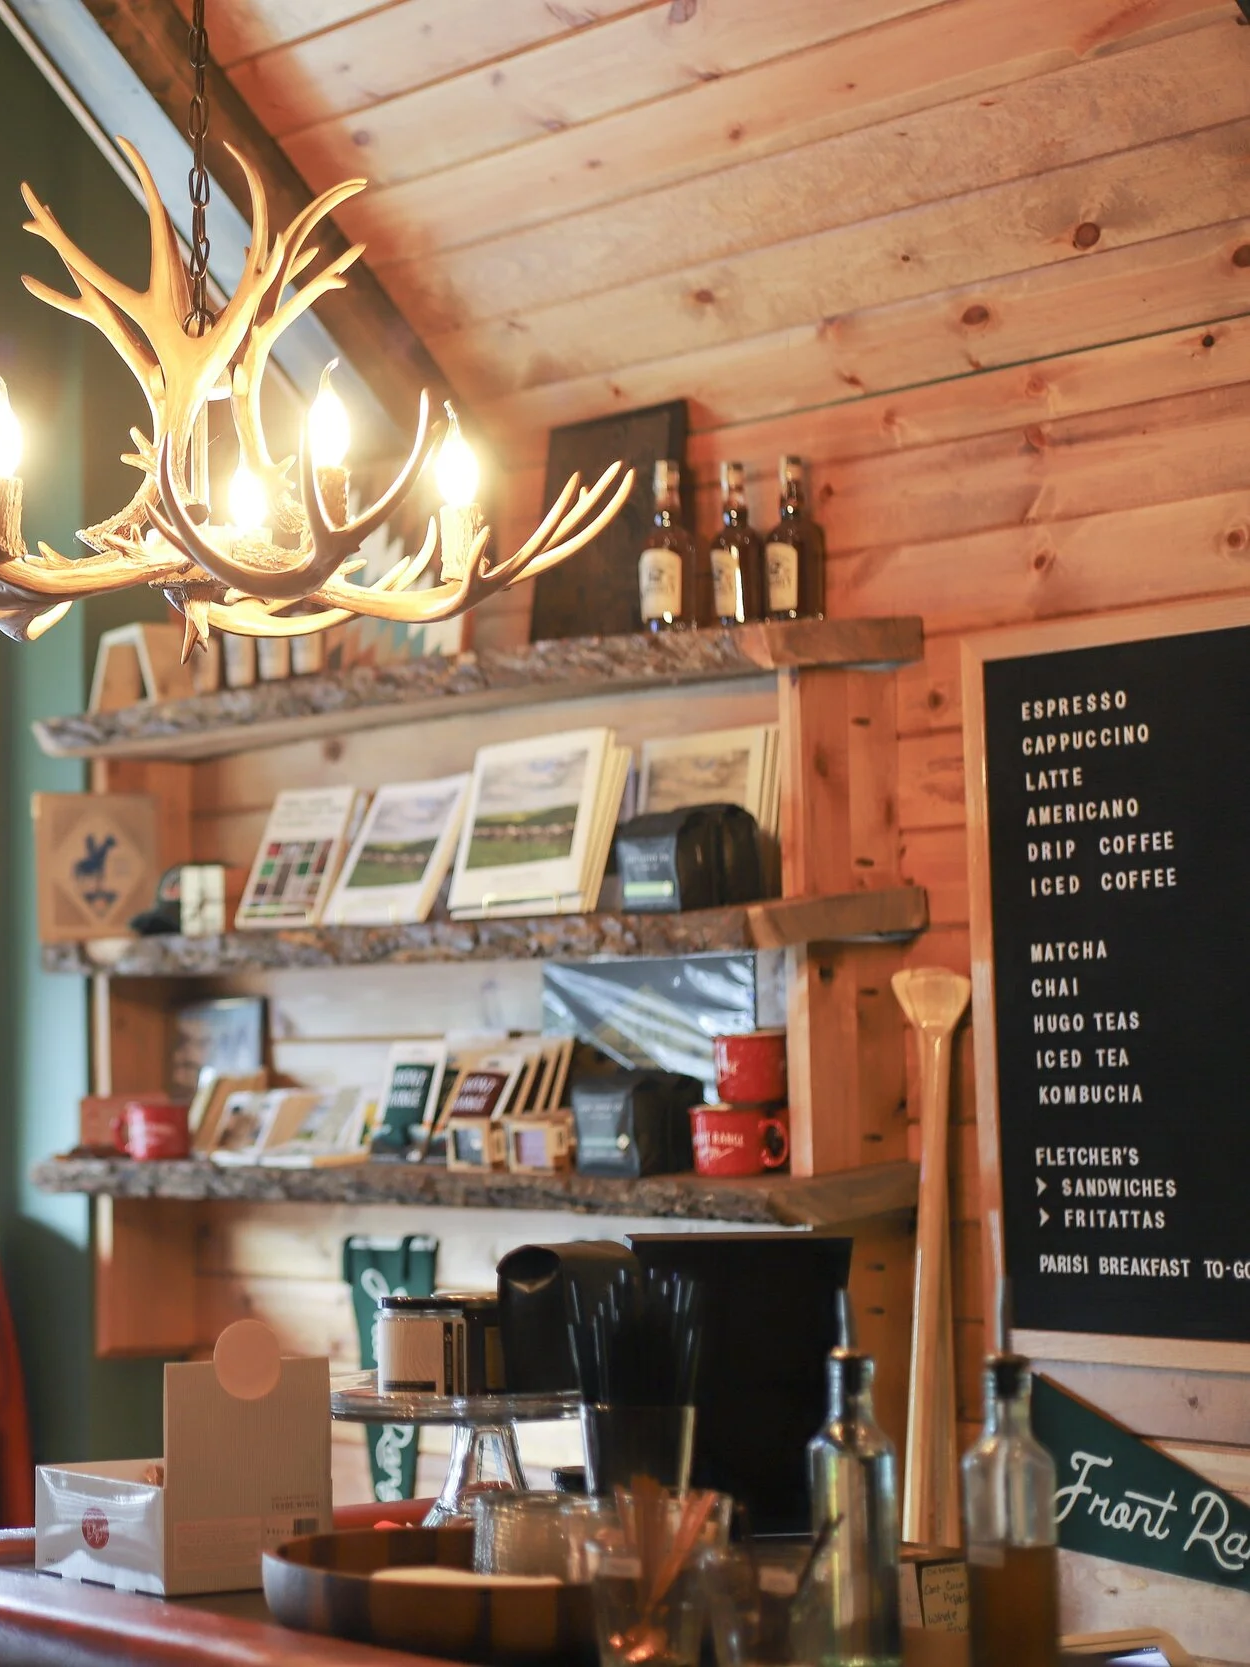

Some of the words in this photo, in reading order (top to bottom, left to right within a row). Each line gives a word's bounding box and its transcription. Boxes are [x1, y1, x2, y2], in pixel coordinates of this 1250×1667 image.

[1022, 691, 1126, 721] ESPRESSO
[1023, 724, 1148, 755] CAPPUCCINO
[1026, 767, 1082, 791] LATTE
[1027, 798, 1138, 826] AMERICANO
[1028, 840, 1075, 861] DRIP
[1099, 831, 1173, 855] COFFEE
[1031, 875, 1079, 896] ICED
[1101, 868, 1176, 891] COFFEE
[1031, 940, 1107, 962] MATCHA
[1032, 978, 1078, 997] CHAI
[1034, 1014, 1084, 1033] HUGO
[1094, 1012, 1139, 1031] TEAS
[1037, 1049, 1081, 1068] ICED
[1096, 1048, 1129, 1067] TEA
[1039, 1085, 1142, 1104] KOMBUCHA
[1036, 1147, 1139, 1165] FLETCHER'S
[1062, 1178, 1176, 1197] SANDWICHES
[1065, 1209, 1164, 1229] FRITATTAS
[1040, 1254, 1088, 1274] PARISI
[1099, 1257, 1190, 1277] BREAKFAST
[1053, 1450, 1178, 1540] Front
